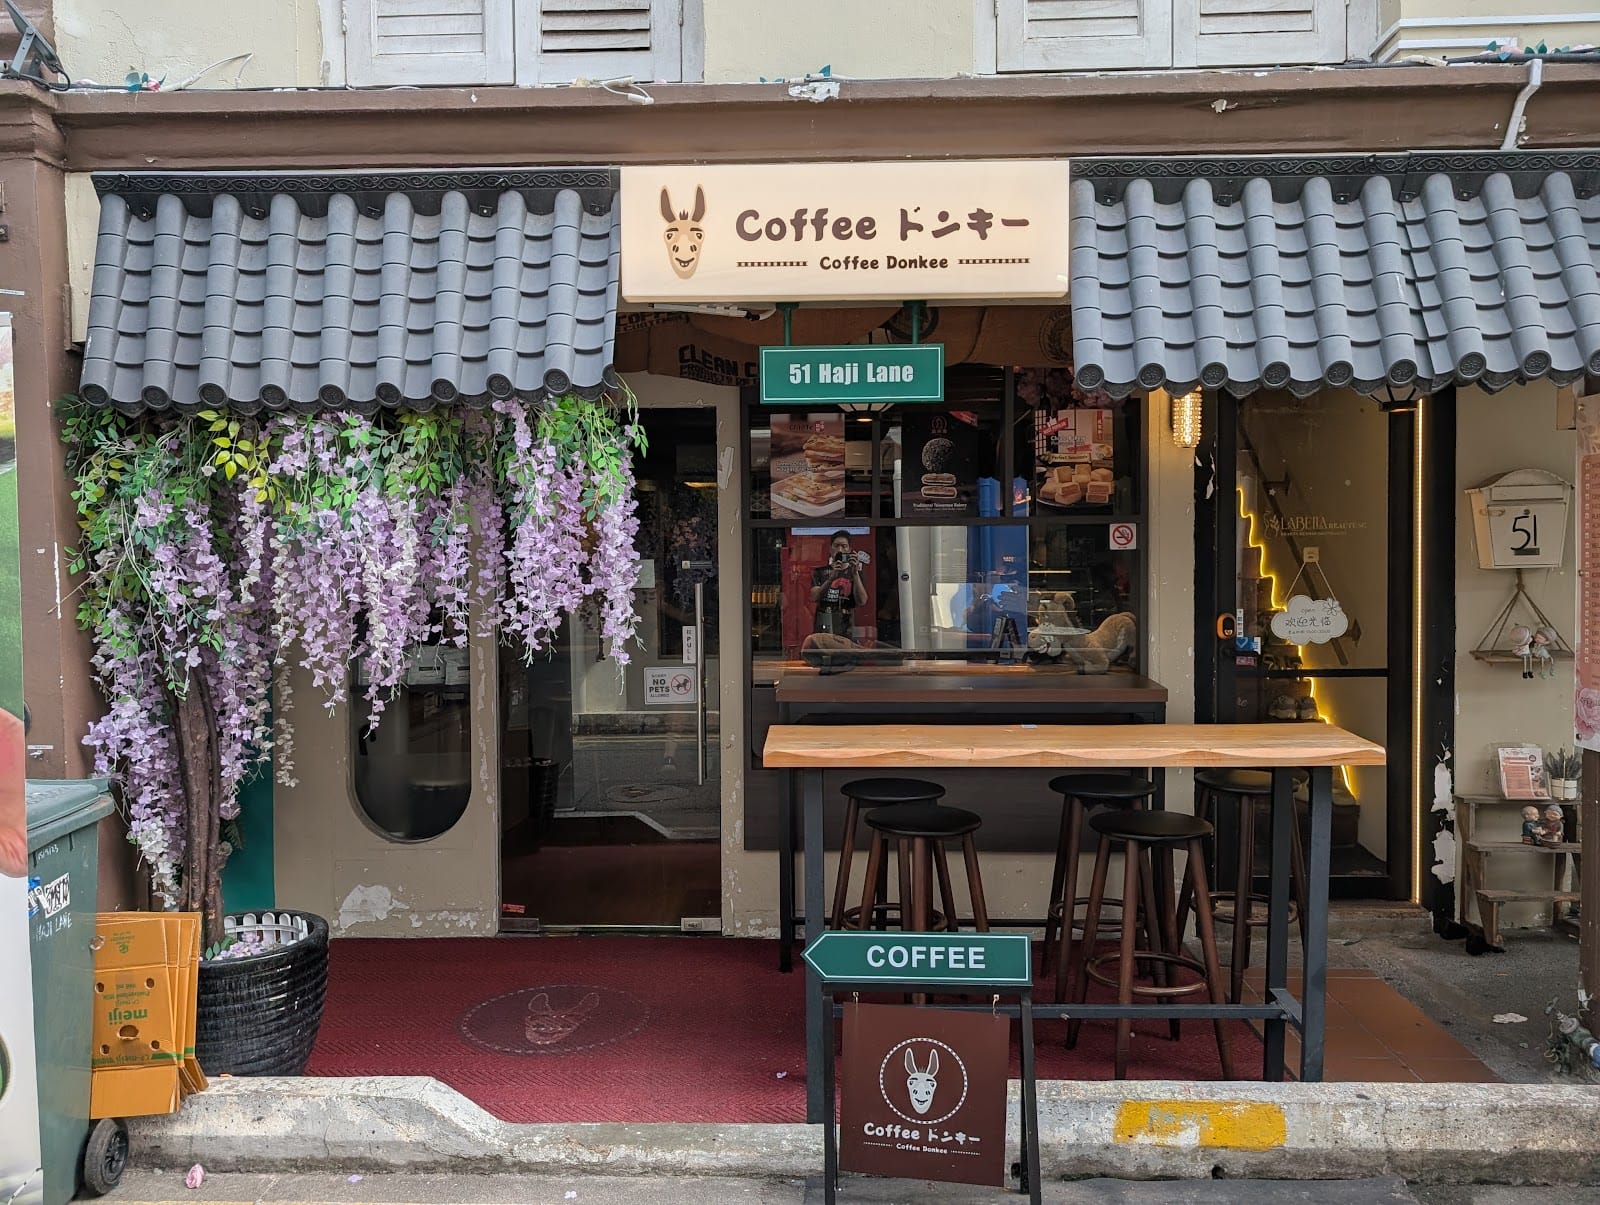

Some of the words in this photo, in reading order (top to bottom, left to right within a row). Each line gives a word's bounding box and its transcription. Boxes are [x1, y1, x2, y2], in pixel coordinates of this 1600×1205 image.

[735, 207, 877, 241] Coffee
[900, 206, 1030, 241] ドンキー
[819, 255, 879, 270] Coffee
[886, 255, 949, 269] Donkee
[678, 343, 739, 378] CLEAN
[789, 363, 811, 384] 51
[819, 363, 859, 385] Haji
[866, 362, 914, 383] Lane
[1510, 515, 1538, 551] 51
[652, 678, 666, 686] NO
[55, 911, 73, 932] LANE
[866, 945, 986, 969] COFFEE
[109, 1008, 148, 1025] meiji
[863, 1122, 921, 1140] Coffee
[928, 1128, 981, 1145] ドンキー
[896, 1143, 921, 1152] Coffee
[922, 1145, 948, 1154] Donkee
